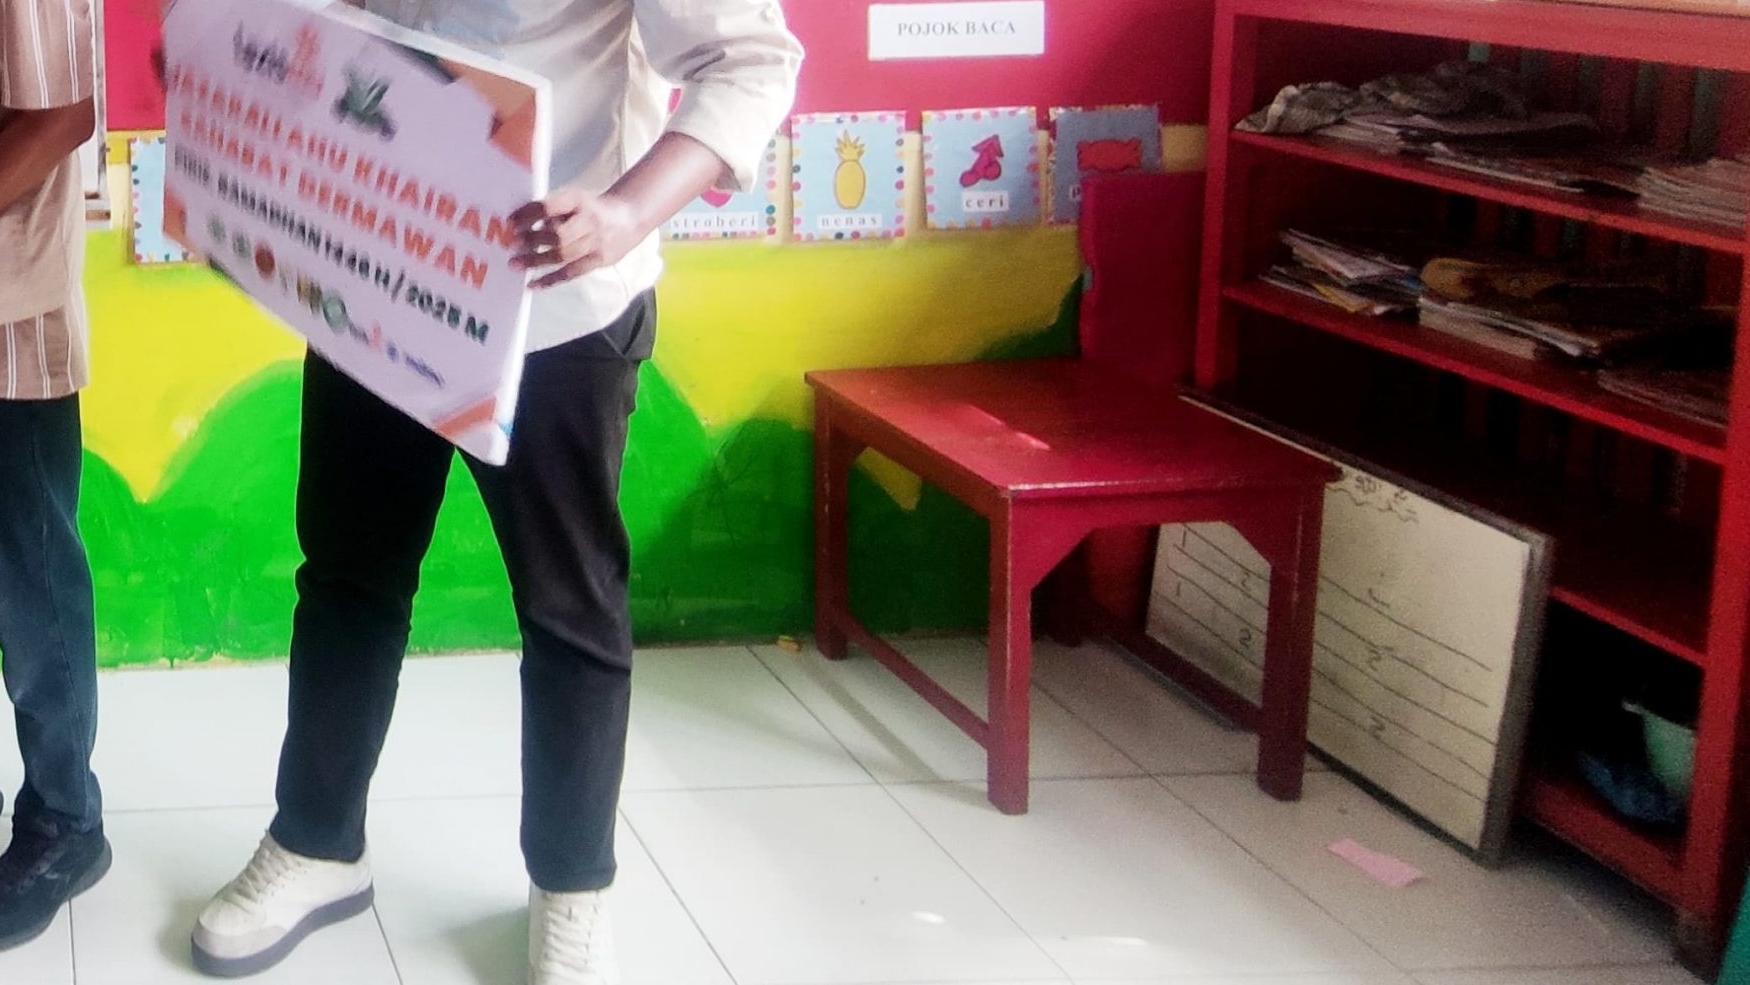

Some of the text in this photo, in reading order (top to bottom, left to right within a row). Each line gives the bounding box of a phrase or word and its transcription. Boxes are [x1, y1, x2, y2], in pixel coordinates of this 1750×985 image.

[897, 20, 1016, 37] POJOK BACA
[965, 196, 1006, 209] ceri
[820, 216, 878, 227] nenas
